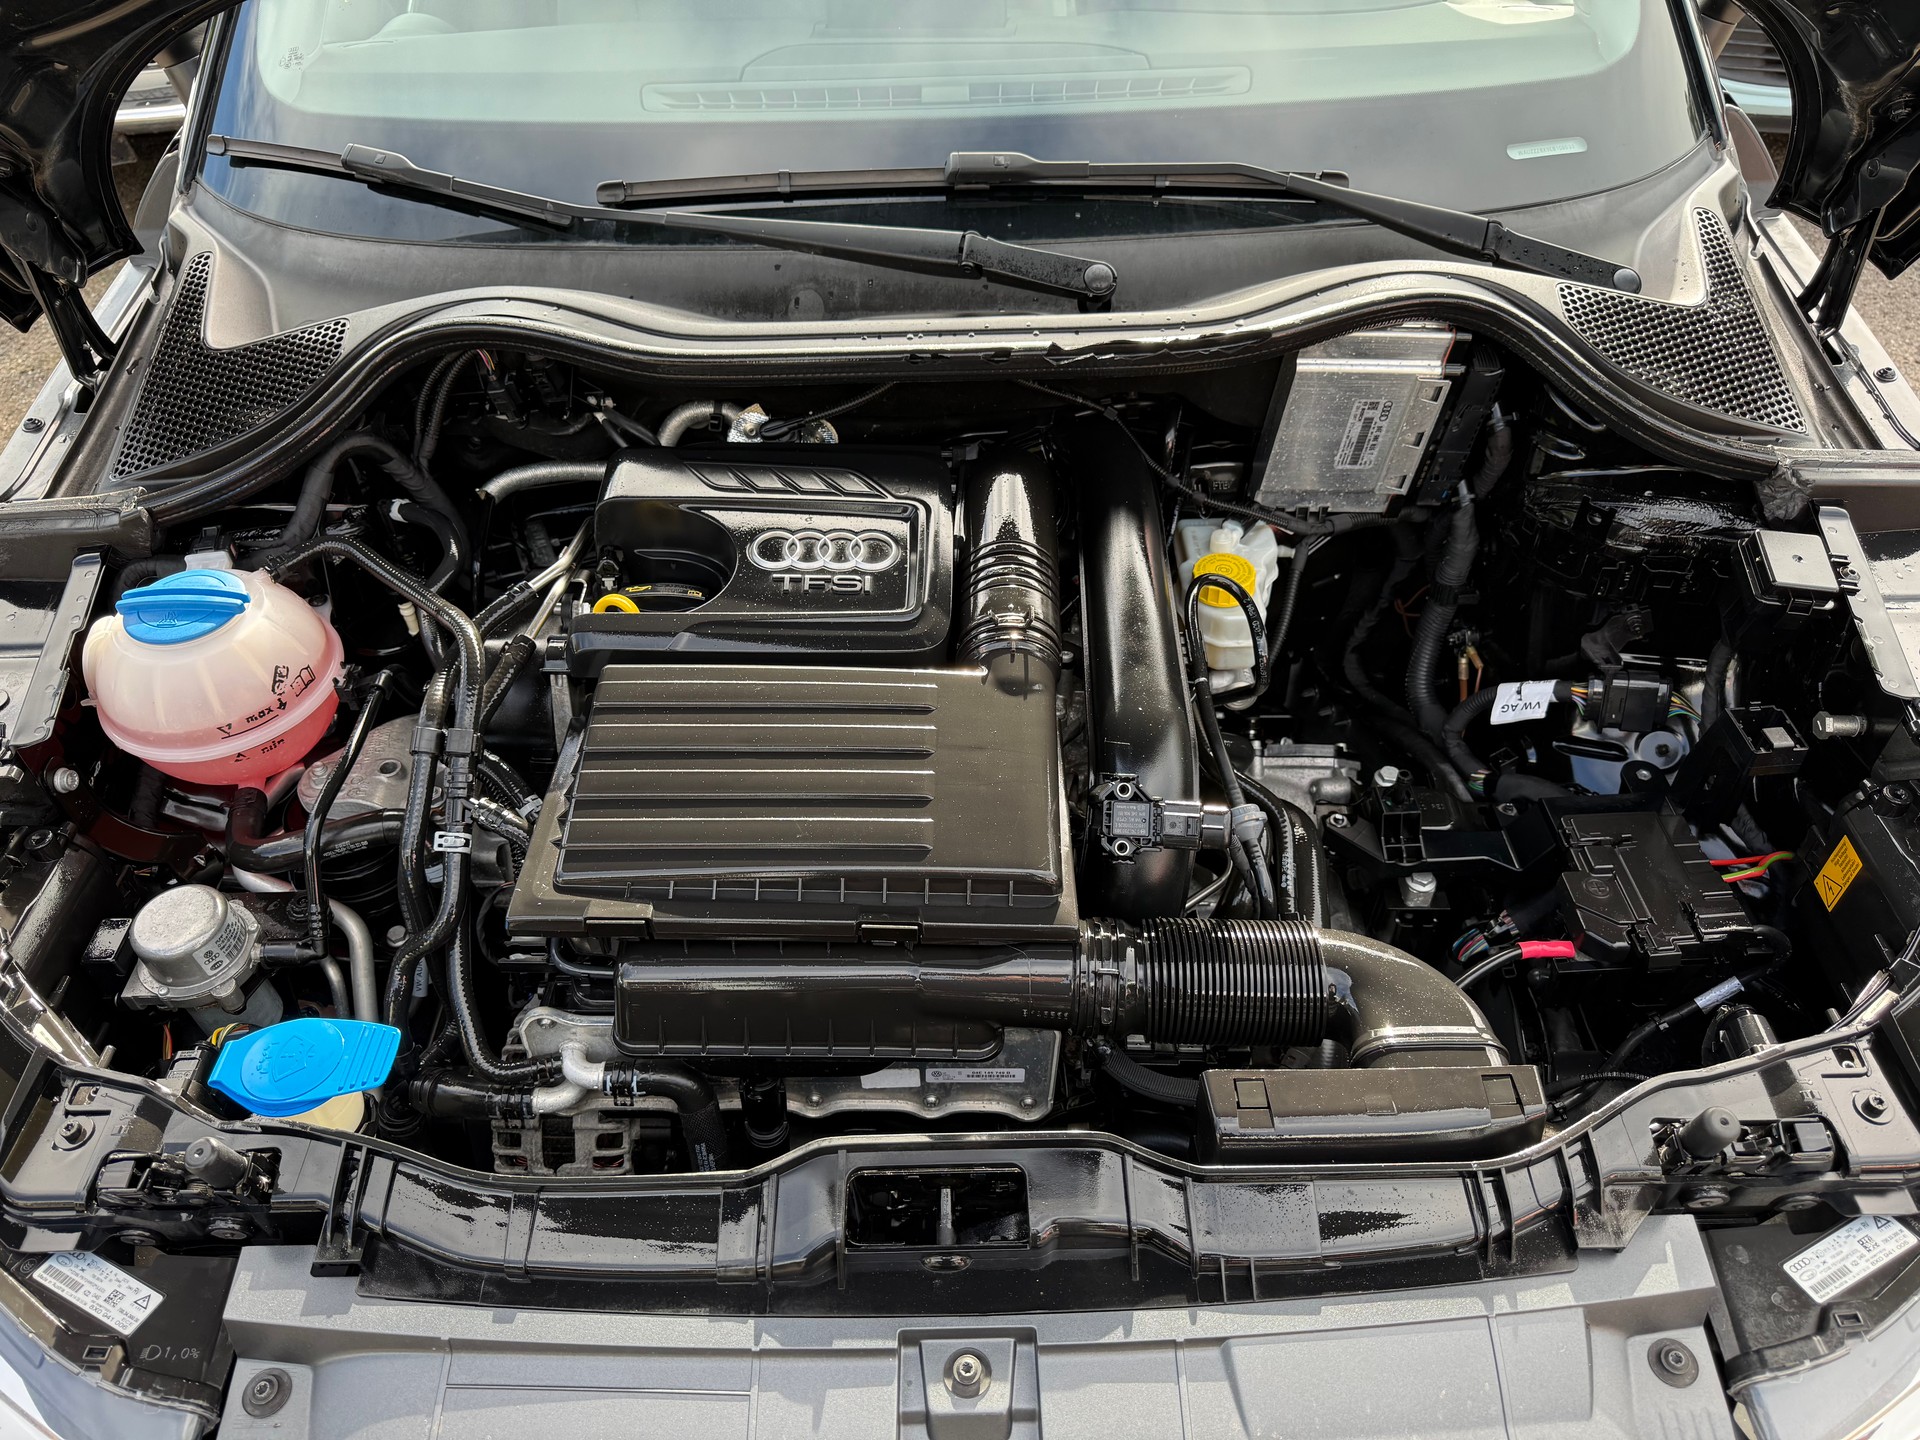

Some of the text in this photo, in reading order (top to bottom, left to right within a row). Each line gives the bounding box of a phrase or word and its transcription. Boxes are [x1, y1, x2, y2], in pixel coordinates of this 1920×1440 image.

[772, 574, 871, 595] TFSI
[245, 705, 275, 724] max
[1500, 701, 1540, 713] VW AG
[88, 1304, 103, 1315] 8X0
